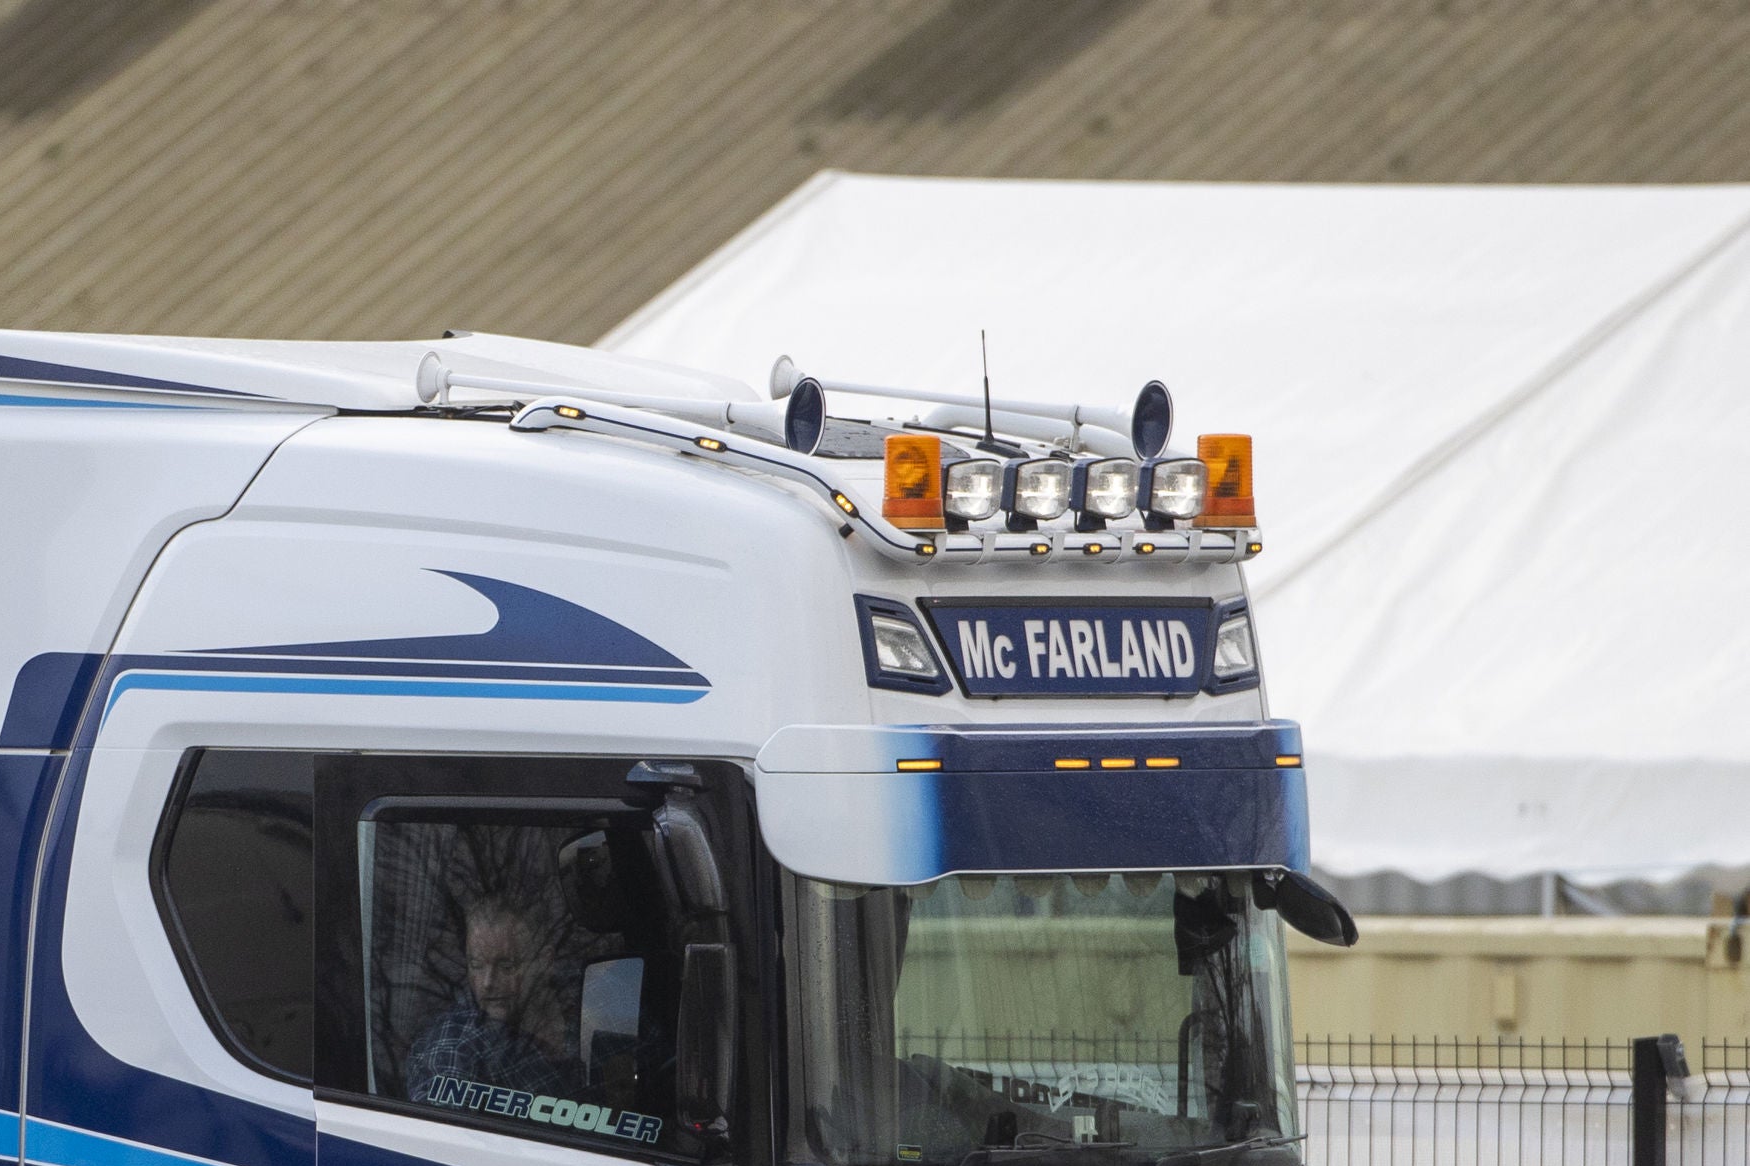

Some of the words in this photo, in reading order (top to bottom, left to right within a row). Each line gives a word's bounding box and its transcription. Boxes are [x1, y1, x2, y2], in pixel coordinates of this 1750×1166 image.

[958, 620, 1017, 679] Mc
[1024, 620, 1195, 679] FARLAND
[427, 1075, 662, 1144] INTERCOOLER
